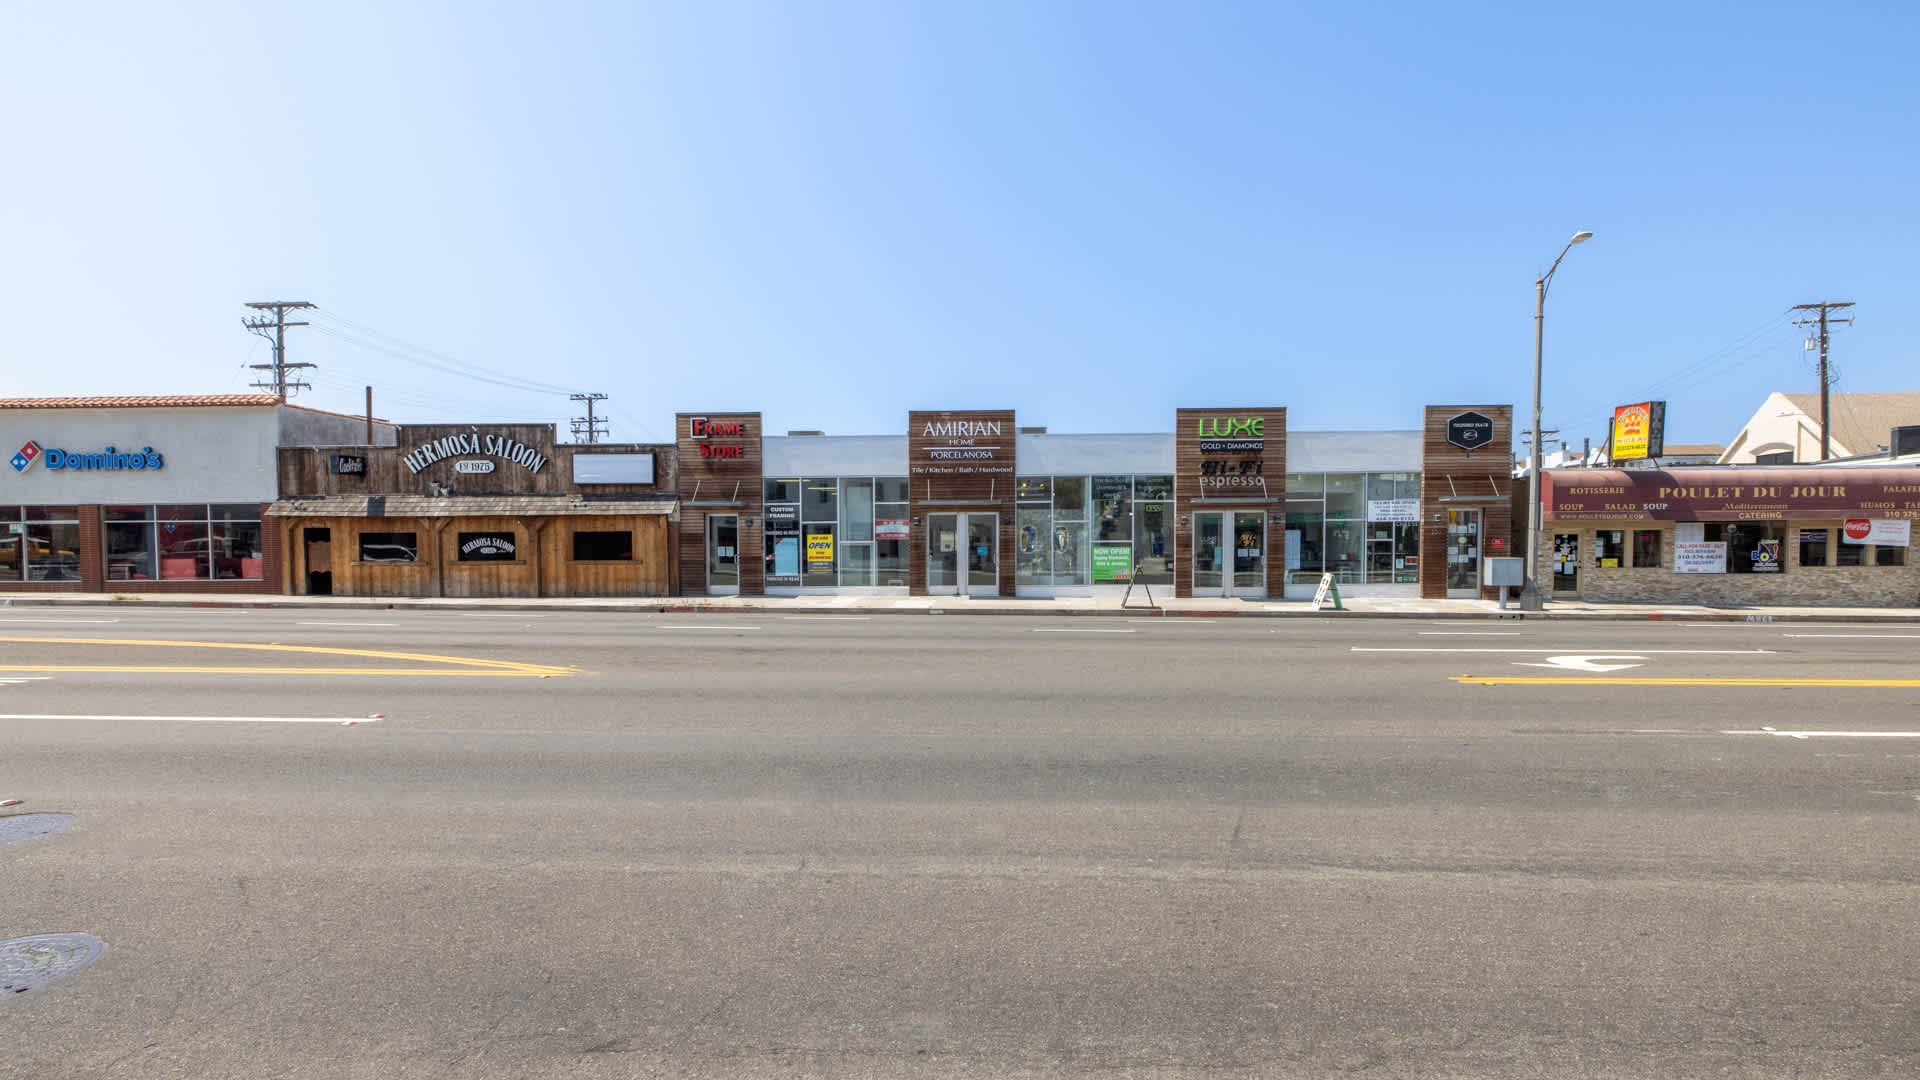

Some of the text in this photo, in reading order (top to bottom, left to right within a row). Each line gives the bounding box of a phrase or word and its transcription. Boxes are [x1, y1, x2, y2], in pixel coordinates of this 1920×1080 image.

[694, 419, 745, 435] FRAME
[923, 421, 1001, 437] AMIRIAN
[1200, 417, 1265, 438] LUXE
[403, 433, 549, 475] HERMOSA SALOON
[699, 441, 745, 458] STORE
[931, 451, 994, 460] PORCELANOSA
[45, 446, 163, 470] Domino's
[471, 463, 490, 472] 1975
[1200, 476, 1265, 489] espresso
[1659, 486, 1847, 498] POULET DU JOUR
[1559, 503, 1669, 511] SOUP SALAD SOUP
